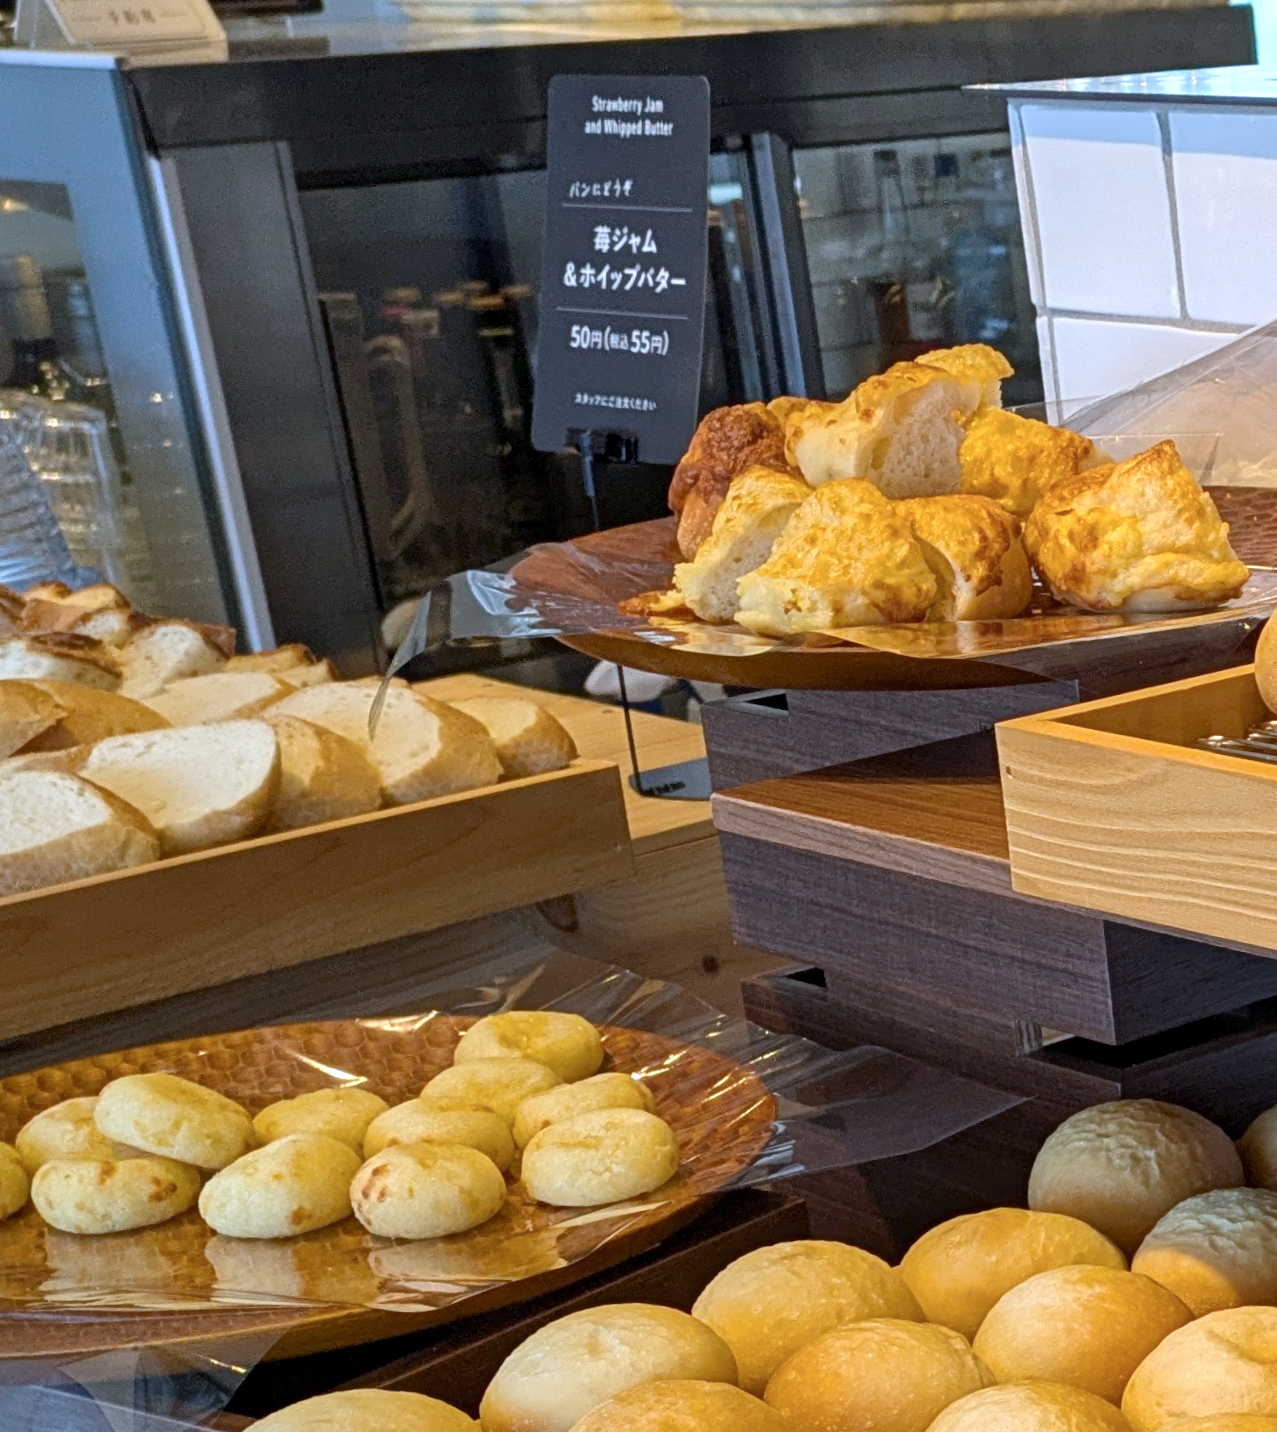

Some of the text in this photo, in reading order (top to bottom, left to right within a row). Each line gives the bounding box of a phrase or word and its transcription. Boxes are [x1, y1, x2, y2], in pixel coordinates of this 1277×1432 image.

[592, 96, 664, 116] Strawberry Jam
[585, 119, 674, 138] and Whipped Butter
[593, 225, 658, 254] 苺ジャム
